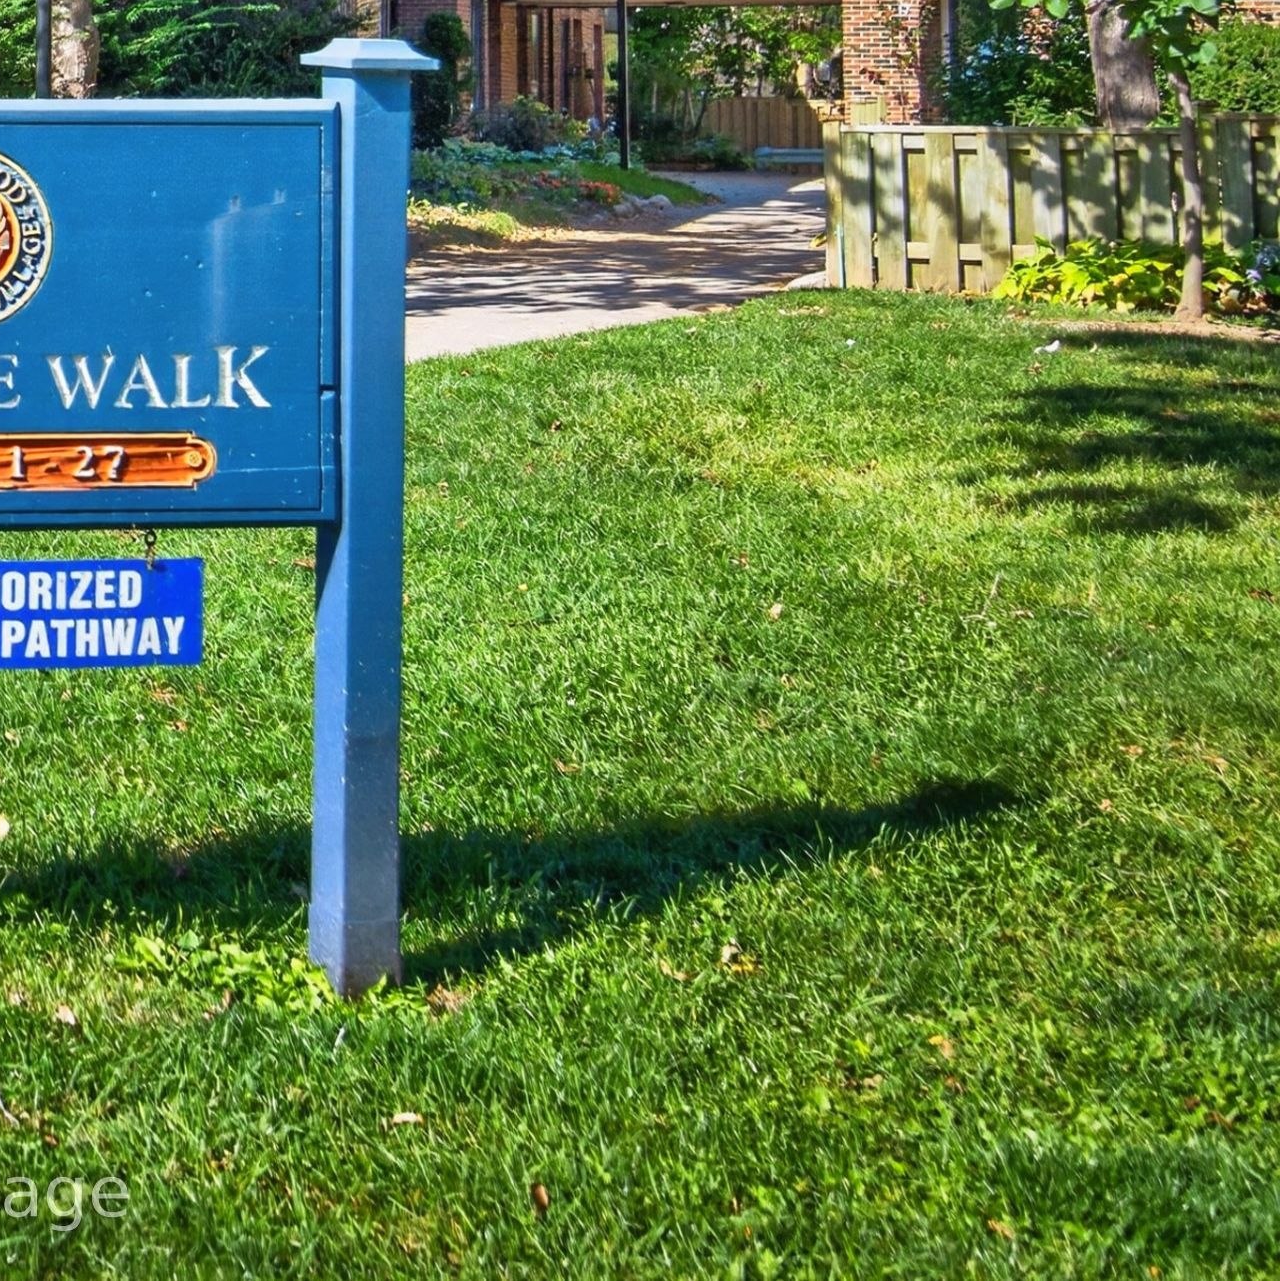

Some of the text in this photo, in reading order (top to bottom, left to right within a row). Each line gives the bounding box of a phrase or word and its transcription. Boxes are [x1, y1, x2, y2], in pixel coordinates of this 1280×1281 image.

[46, 345, 272, 409] WALK
[8, 445, 26, 480] 1
[76, 445, 125, 479] 27
[1, 616, 186, 658] PATHWAY
